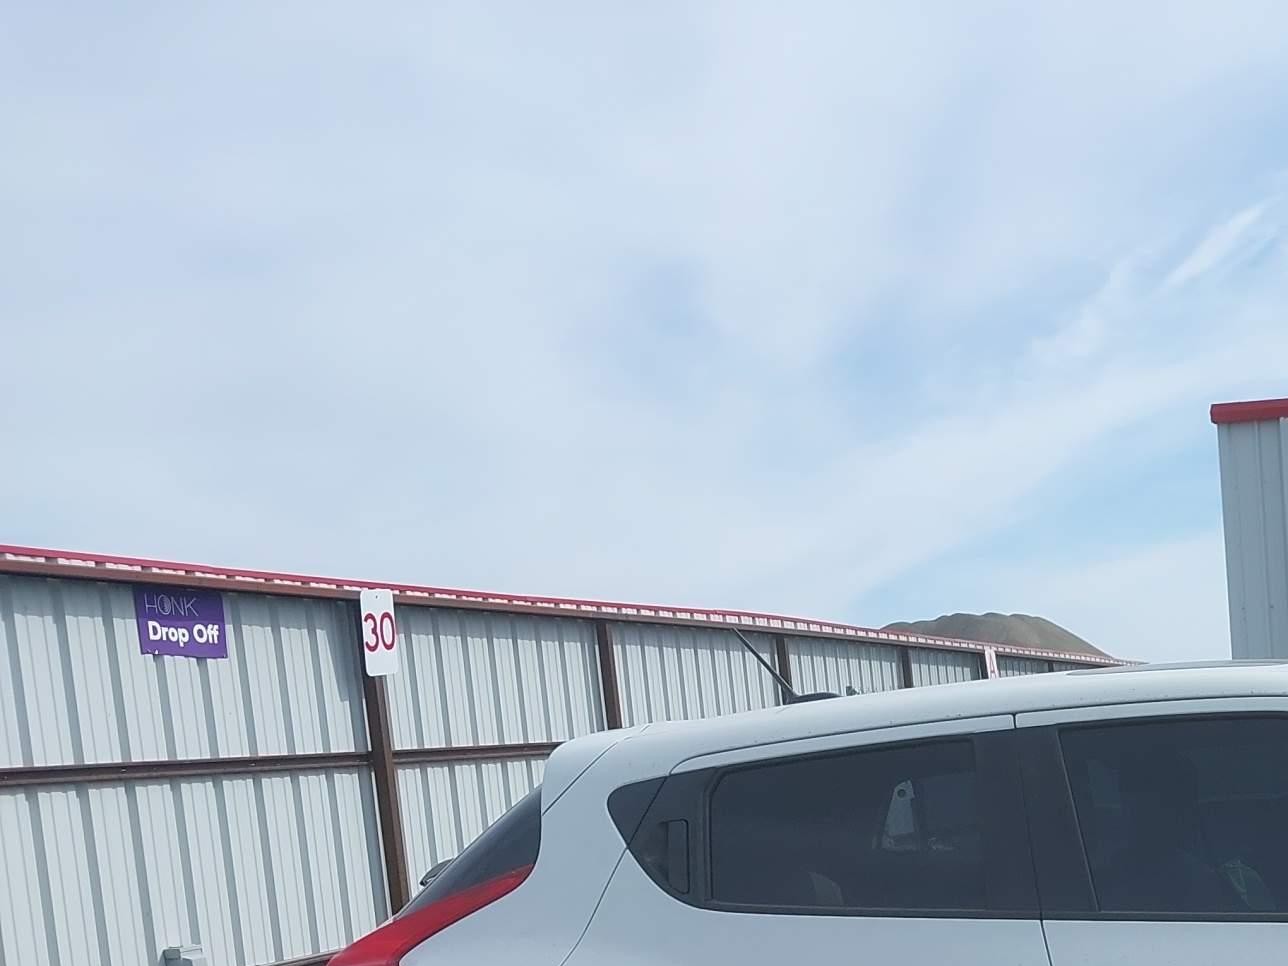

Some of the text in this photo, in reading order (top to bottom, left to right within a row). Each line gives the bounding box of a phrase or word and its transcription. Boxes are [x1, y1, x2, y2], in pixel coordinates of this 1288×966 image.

[144, 593, 199, 617] HONK
[147, 620, 219, 647] Drop Off
[364, 612, 396, 652] 30
